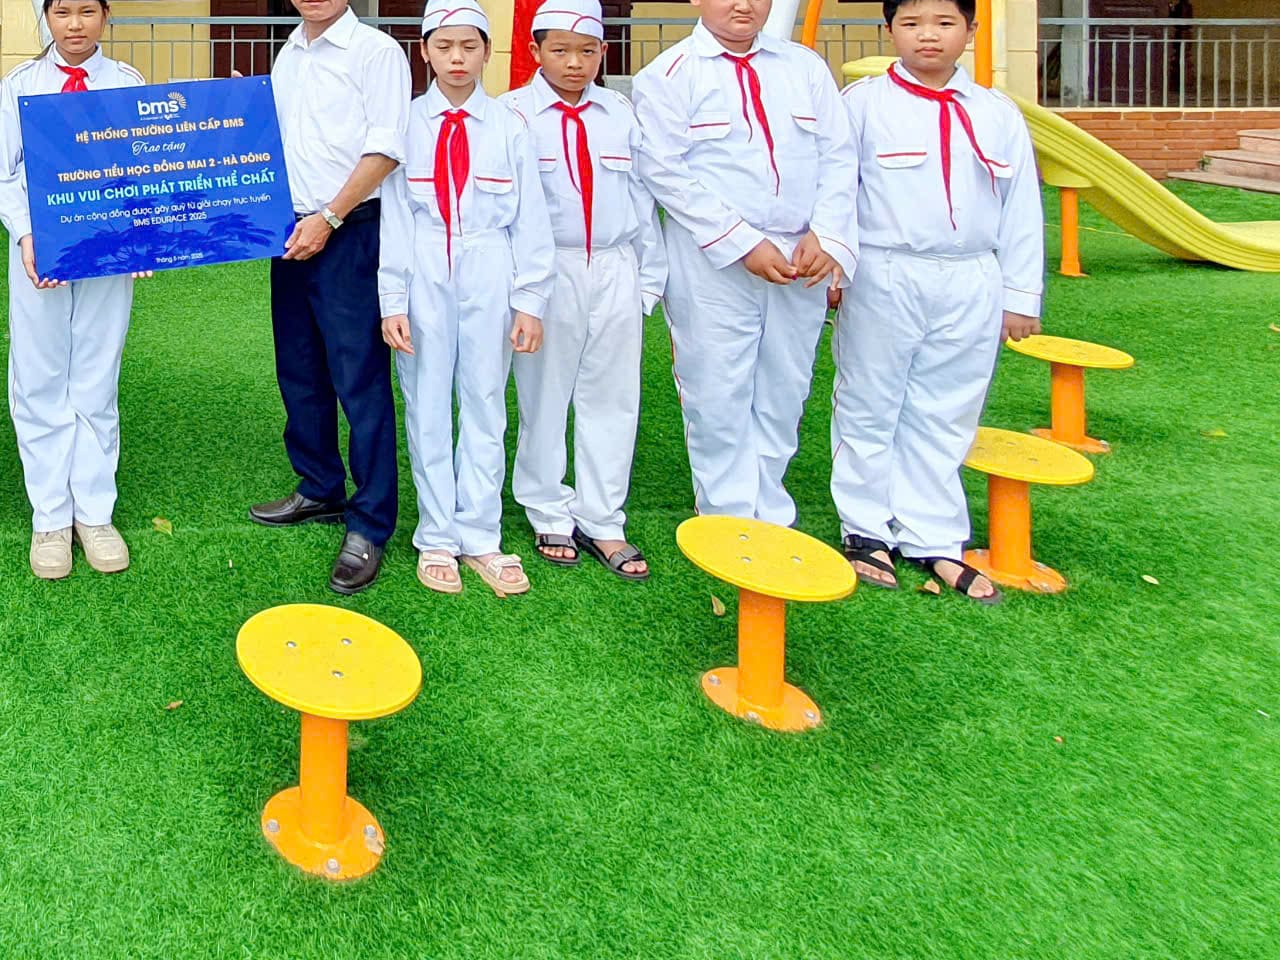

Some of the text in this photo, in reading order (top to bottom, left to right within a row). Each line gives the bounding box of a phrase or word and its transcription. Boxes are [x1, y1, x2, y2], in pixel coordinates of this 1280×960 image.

[137, 100, 179, 116] bms
[75, 117, 244, 144] HỆ THỐNG TRƯỜNG LIÊN CẤP BMS
[131, 140, 160, 156] Trao
[57, 168, 101, 182] TRƯỜNG
[103, 162, 124, 178] TIỂU
[127, 164, 151, 176] HỌC
[153, 158, 184, 173] ĐỒNG
[187, 159, 207, 169] MAI
[208, 158, 216, 167] 2
[223, 153, 239, 165] HÀ
[239, 152, 271, 164] ĐÔNG
[46, 167, 275, 205] KHU VUI CHƠI PHÁT TRIỂN THỂ CHẤT
[60, 215, 72, 224] Dự
[86, 211, 107, 221] cộng
[133, 211, 207, 227] BMS EDURACE 2025
